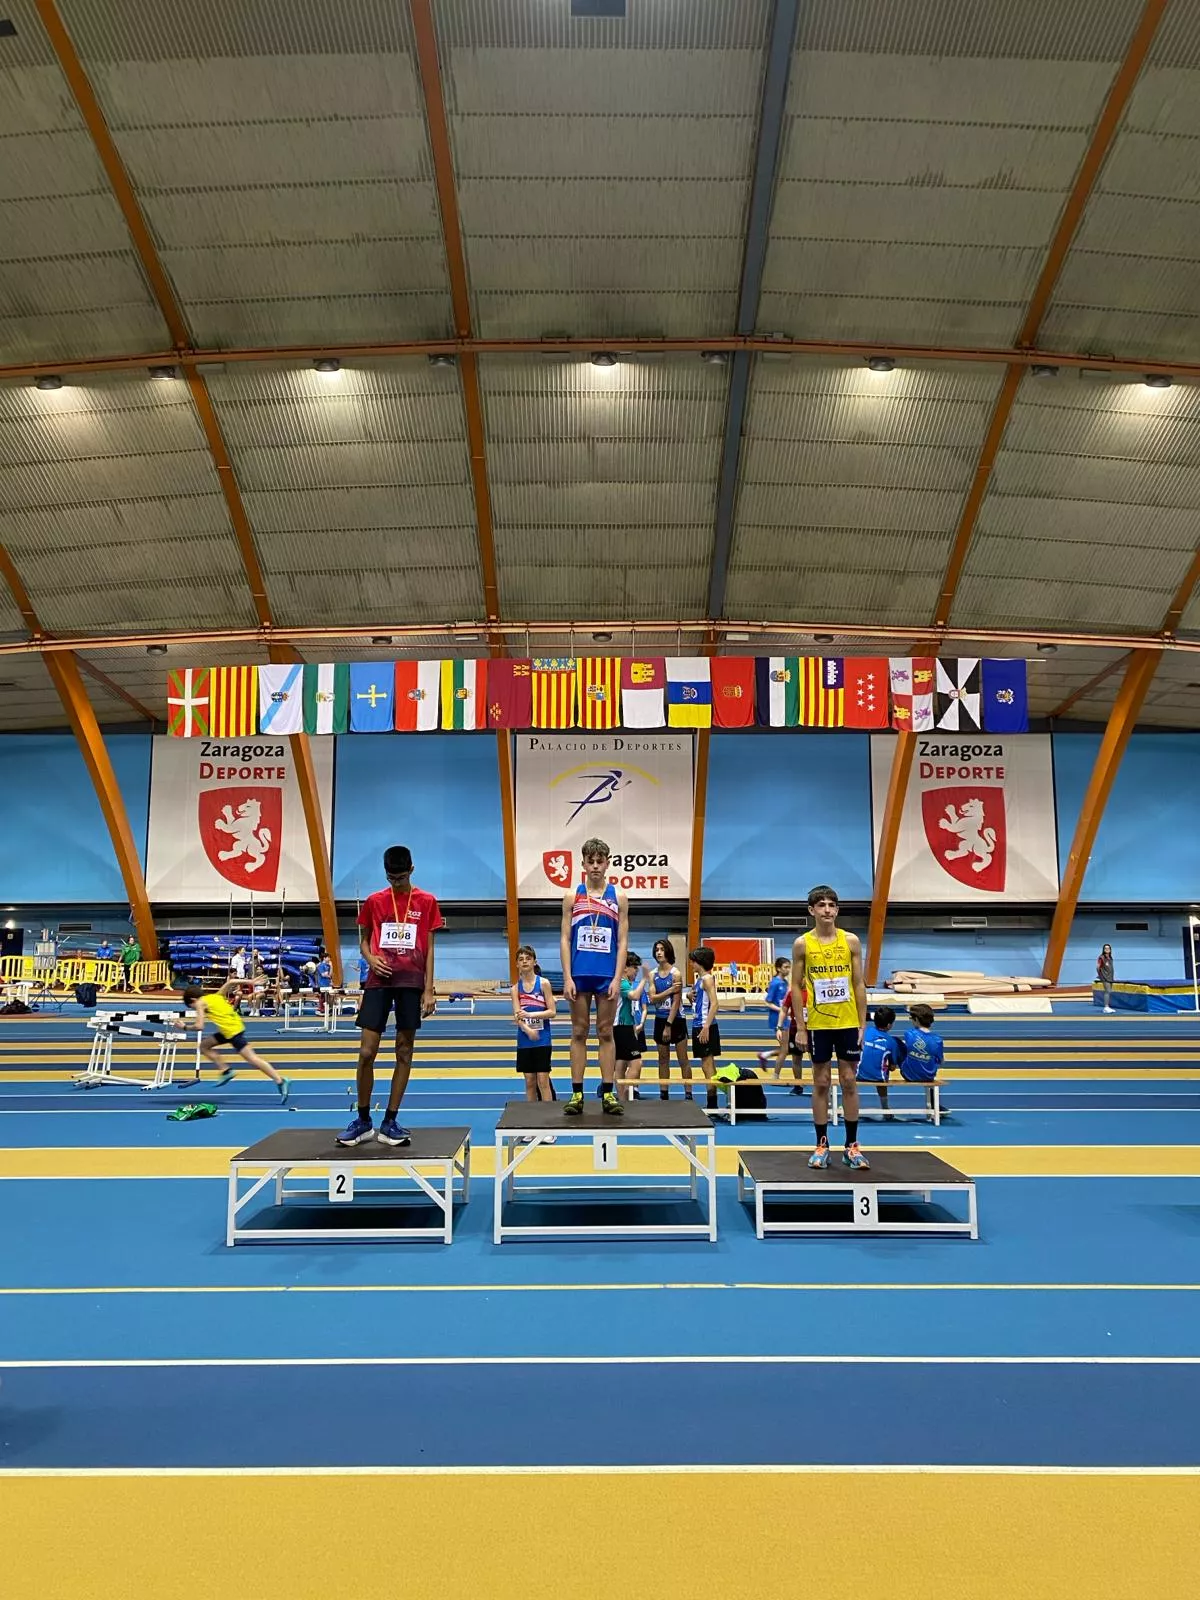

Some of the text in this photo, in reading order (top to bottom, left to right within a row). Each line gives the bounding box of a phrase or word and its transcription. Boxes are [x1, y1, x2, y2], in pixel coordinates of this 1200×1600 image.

[200, 741, 285, 762] Zaragoza
[529, 738, 682, 751] PALACIO DE DEPORTES
[919, 741, 1004, 762] Zaragoza
[200, 762, 286, 780] DEPORTE
[919, 762, 1005, 780] DEPORTE
[607, 853, 669, 872] ragoza
[581, 872, 669, 889] PORTE
[581, 934, 606, 944] 1164
[820, 988, 846, 999] 1028
[601, 1142, 607, 1163] 1
[335, 1174, 346, 1195] 2
[860, 1196, 870, 1217] 3
